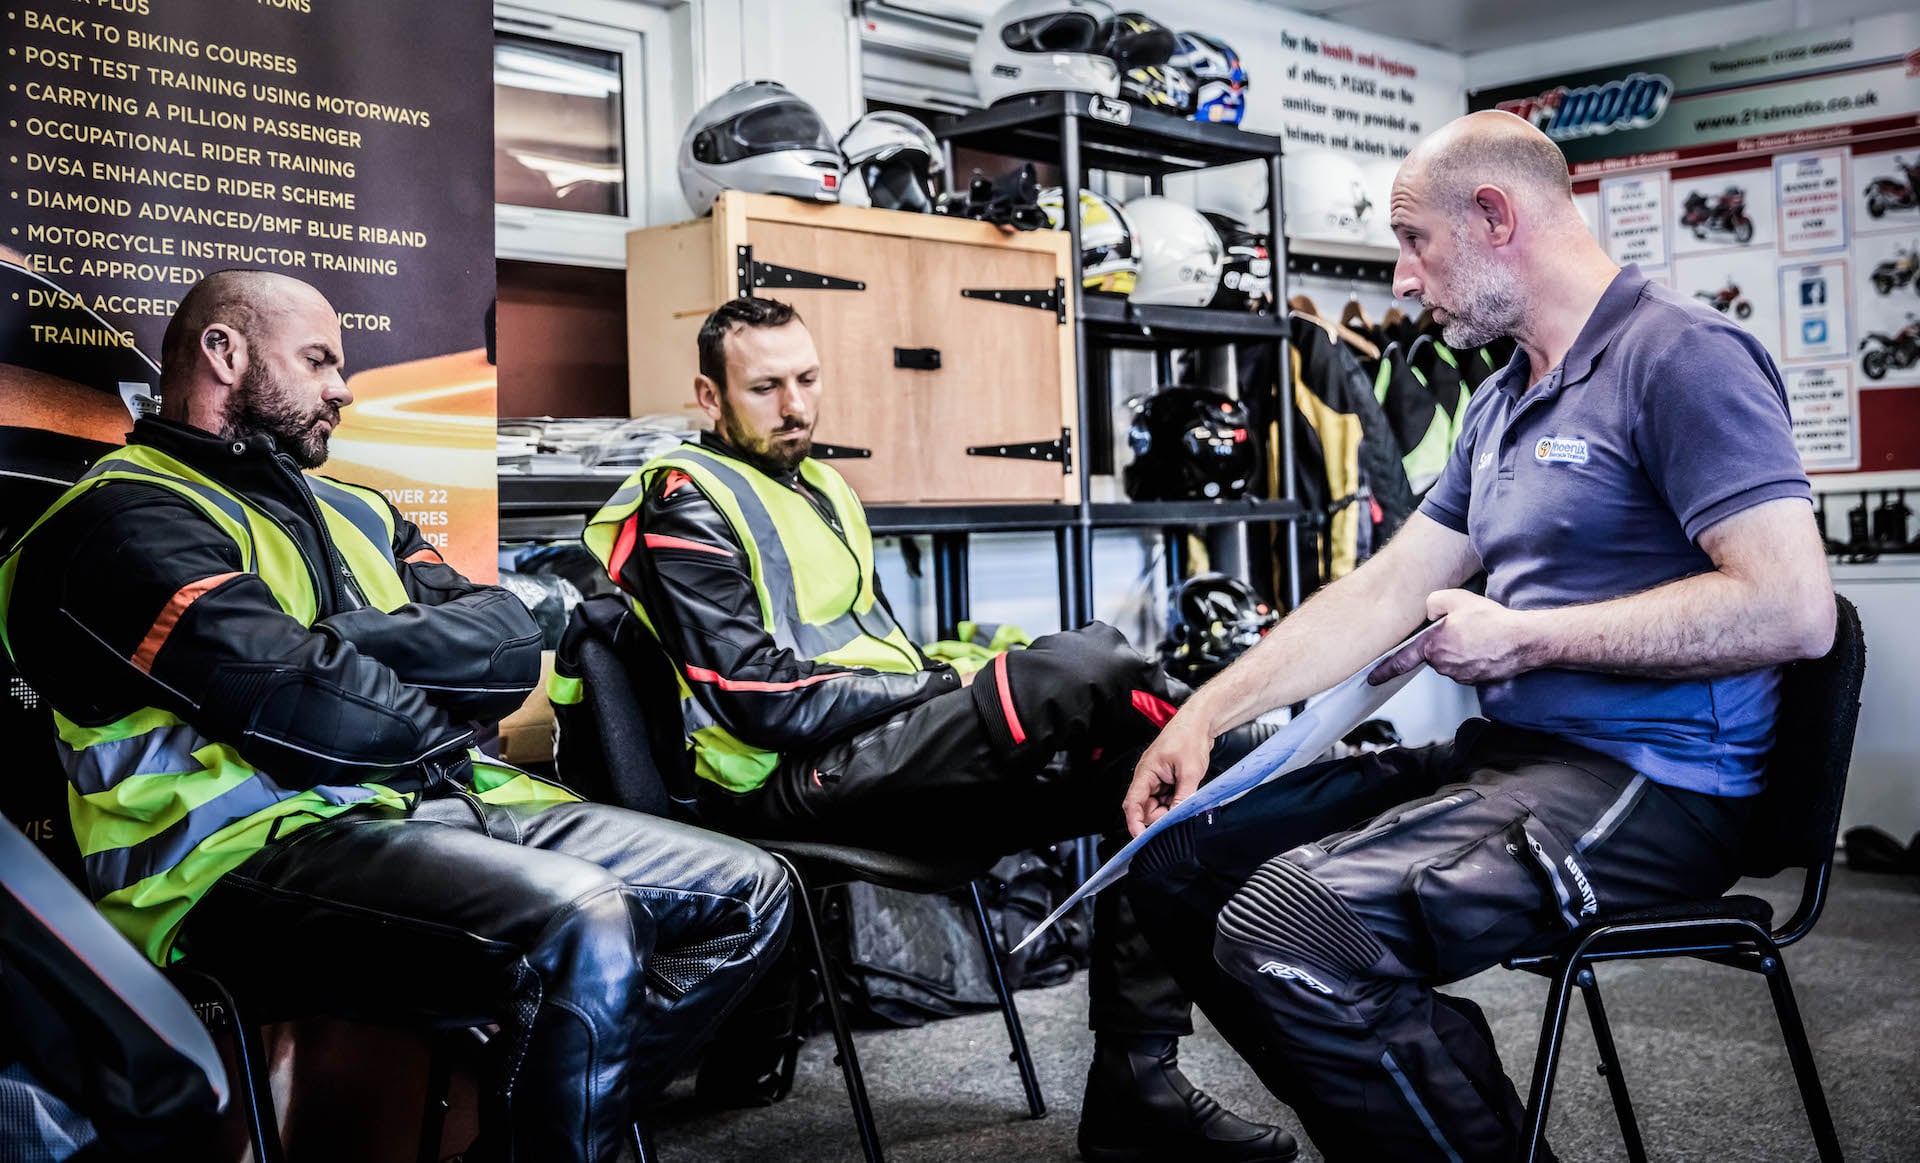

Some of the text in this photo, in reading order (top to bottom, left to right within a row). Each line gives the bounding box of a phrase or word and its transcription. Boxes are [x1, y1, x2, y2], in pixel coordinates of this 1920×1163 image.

[25, 10, 297, 75] BACK TO BIKING COURSES
[25, 46, 431, 128] POST TEST TRAINING USING MOTORWAYS
[25, 82, 362, 148] CARRYING A PILLION PASSENGER
[26, 117, 356, 179] OCCUPATIONAL RIDER TRAINING
[27, 153, 356, 210] DVSA ENHANCED RIDER SCHEME
[27, 188, 427, 249] DIAMOND ADVANCED/BMF BLUE RIBAND
[24, 253, 74, 275] (ELC
[27, 223, 398, 276] MOTORCYCLE INSTRUCTOR TRAINING
[28, 288, 87, 311] DVSA
[93, 295, 180, 317] ACCRED
[30, 324, 136, 349] TRAINING
[403, 511, 449, 526] TRES
[428, 489, 448, 505] 22
